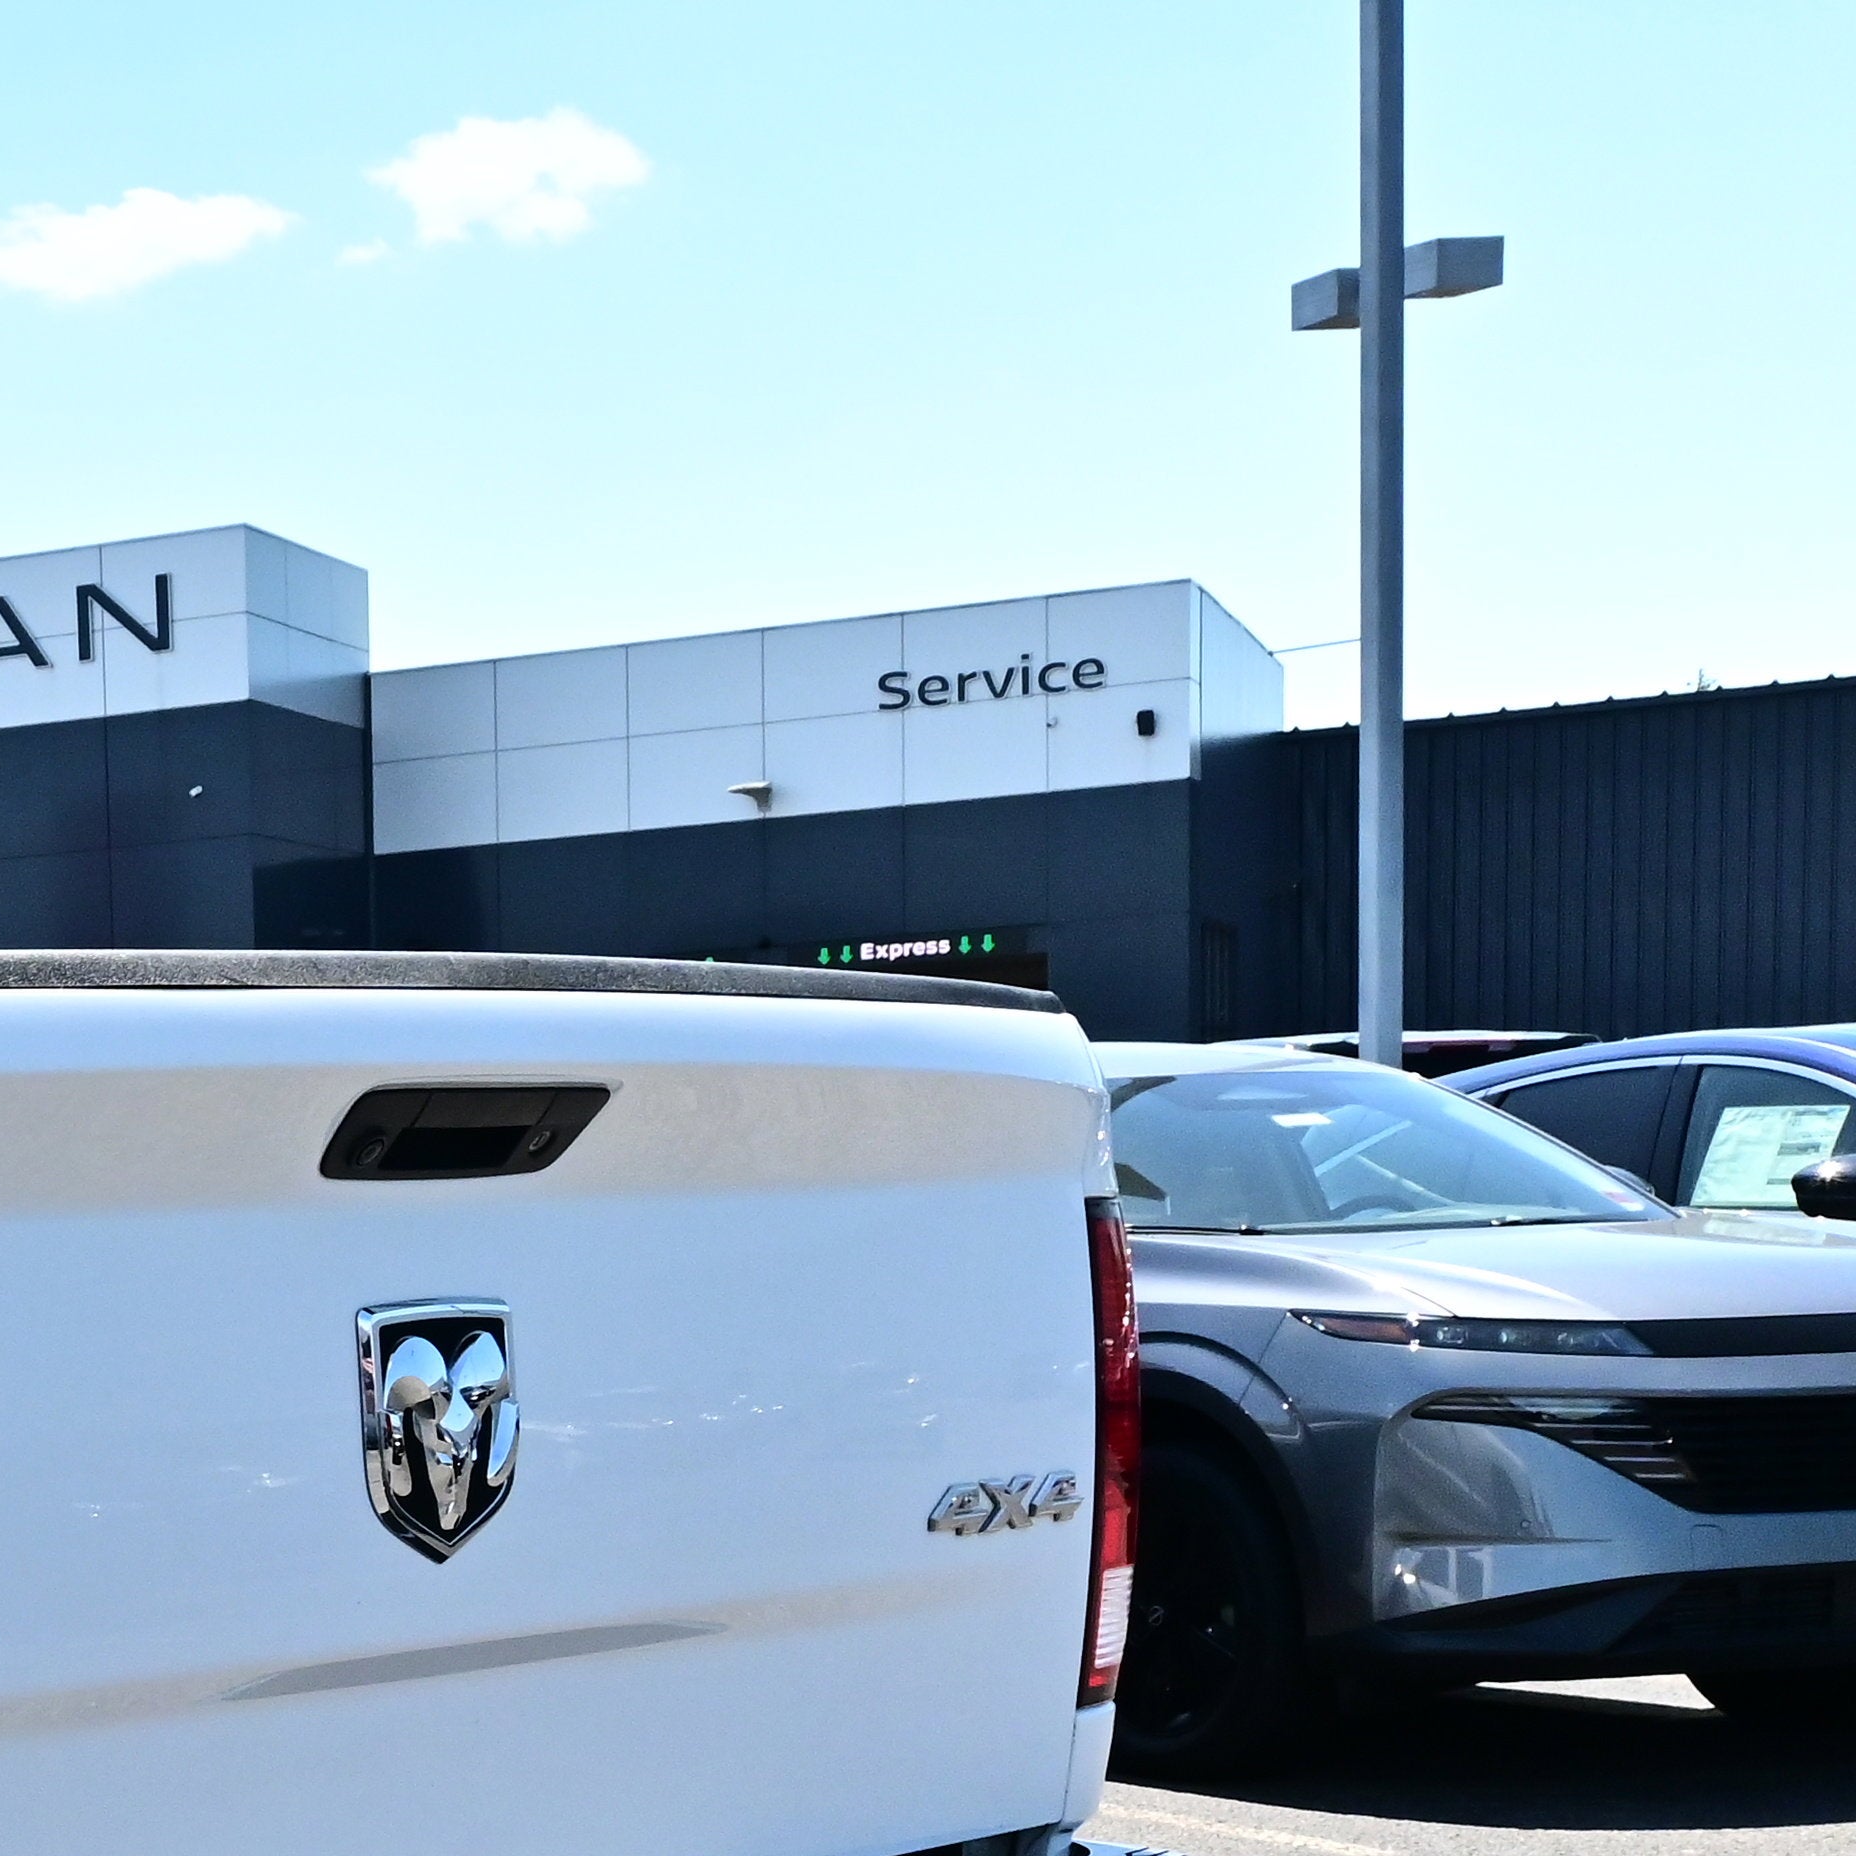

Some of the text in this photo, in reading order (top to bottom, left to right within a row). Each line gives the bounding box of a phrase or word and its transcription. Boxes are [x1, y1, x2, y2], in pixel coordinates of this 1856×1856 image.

[876, 653, 1107, 712] Service
[859, 937, 951, 963] Express
[927, 1469, 1084, 1535] 4X4
